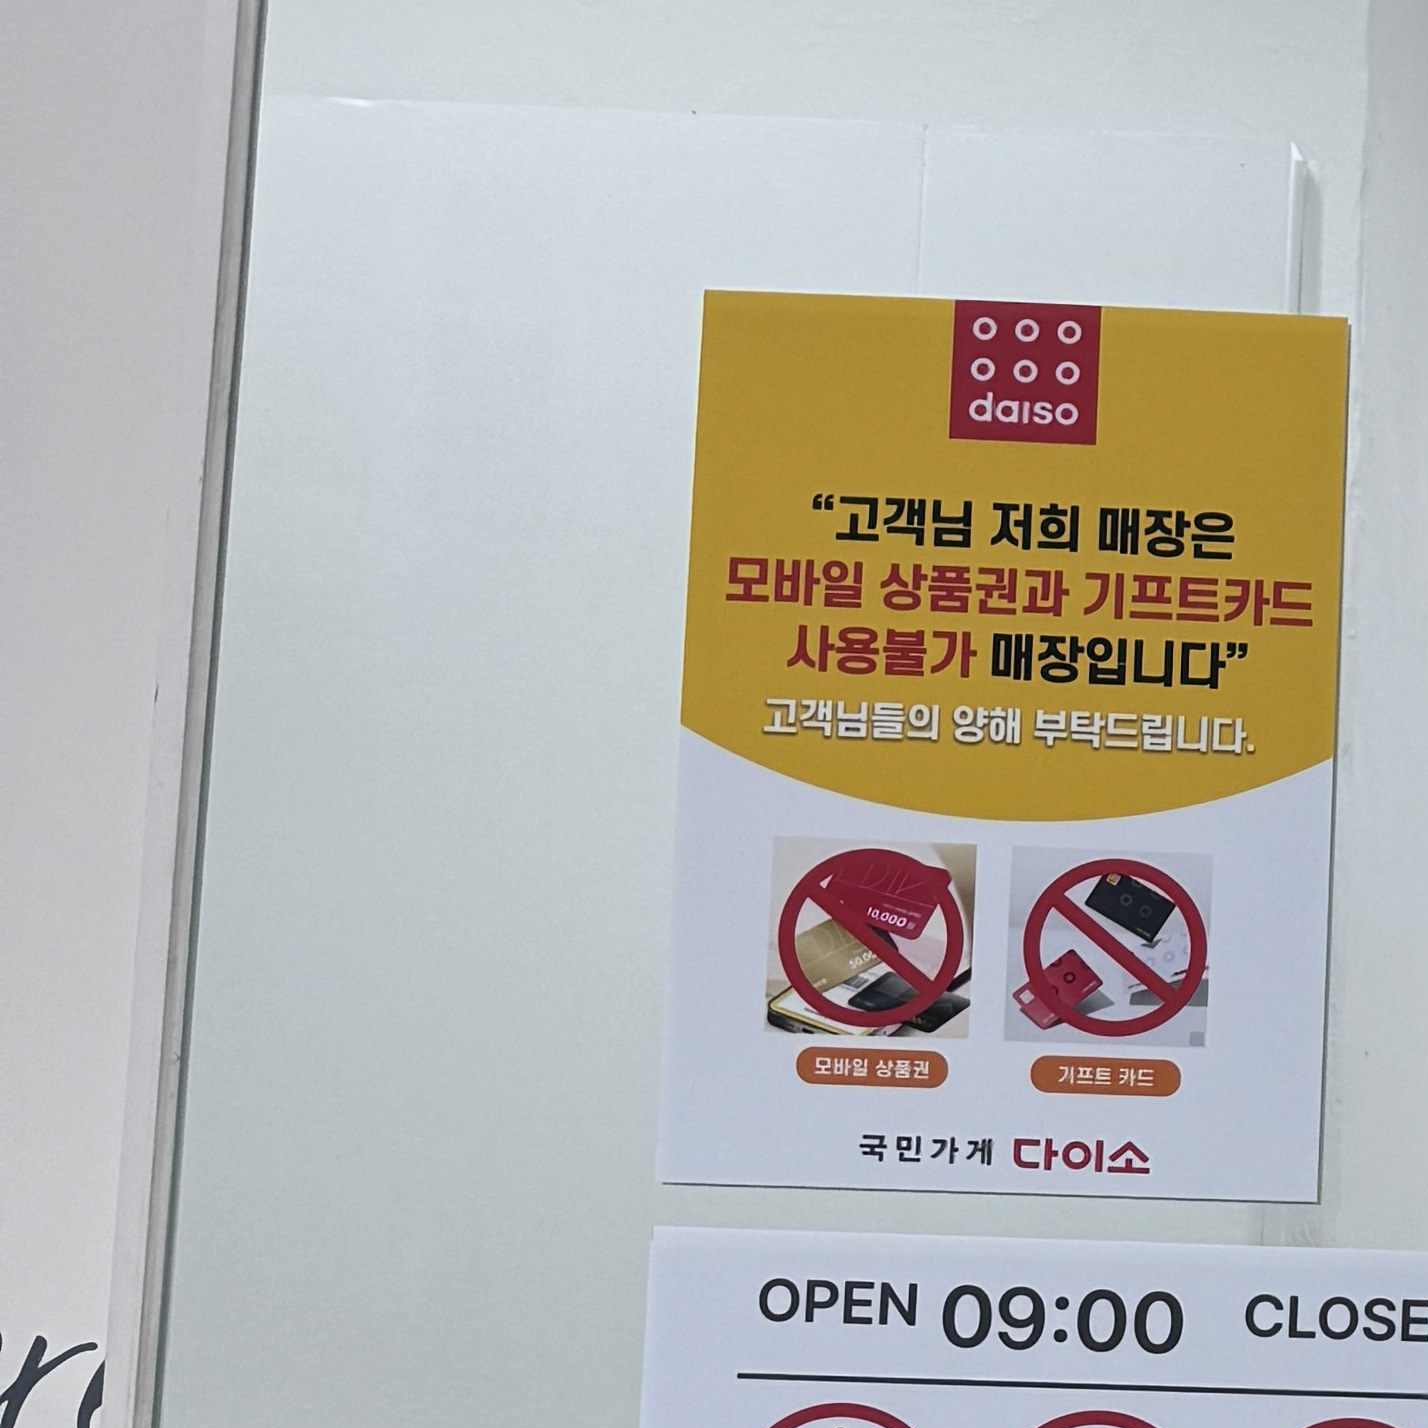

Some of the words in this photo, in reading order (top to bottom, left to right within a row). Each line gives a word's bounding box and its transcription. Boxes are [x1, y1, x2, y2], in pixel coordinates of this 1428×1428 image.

[969, 392, 1078, 425] daiso
[813, 494, 972, 548] “고객님
[991, 503, 1079, 552] 저희
[1099, 508, 1234, 559] 매장은
[726, 557, 863, 608] 모바일
[881, 563, 1069, 617] 상품권과
[1084, 573, 1313, 626] 기프트카드
[787, 625, 977, 678] 사용불가
[992, 633, 1248, 689] 매장입니다”
[762, 699, 940, 743] 고객님들의
[952, 706, 1022, 746] 양해
[1034, 710, 1255, 756] 부탁드립니다.
[815, 1058, 867, 1076] 모바일
[876, 1060, 929, 1078] 상품권
[1059, 1067, 1111, 1084] 기프트
[1119, 1069, 1153, 1086] 카드
[1014, 1138, 1150, 1174] 다이소
[759, 1279, 917, 1326] OPEN
[943, 1285, 1183, 1354] 09:00
